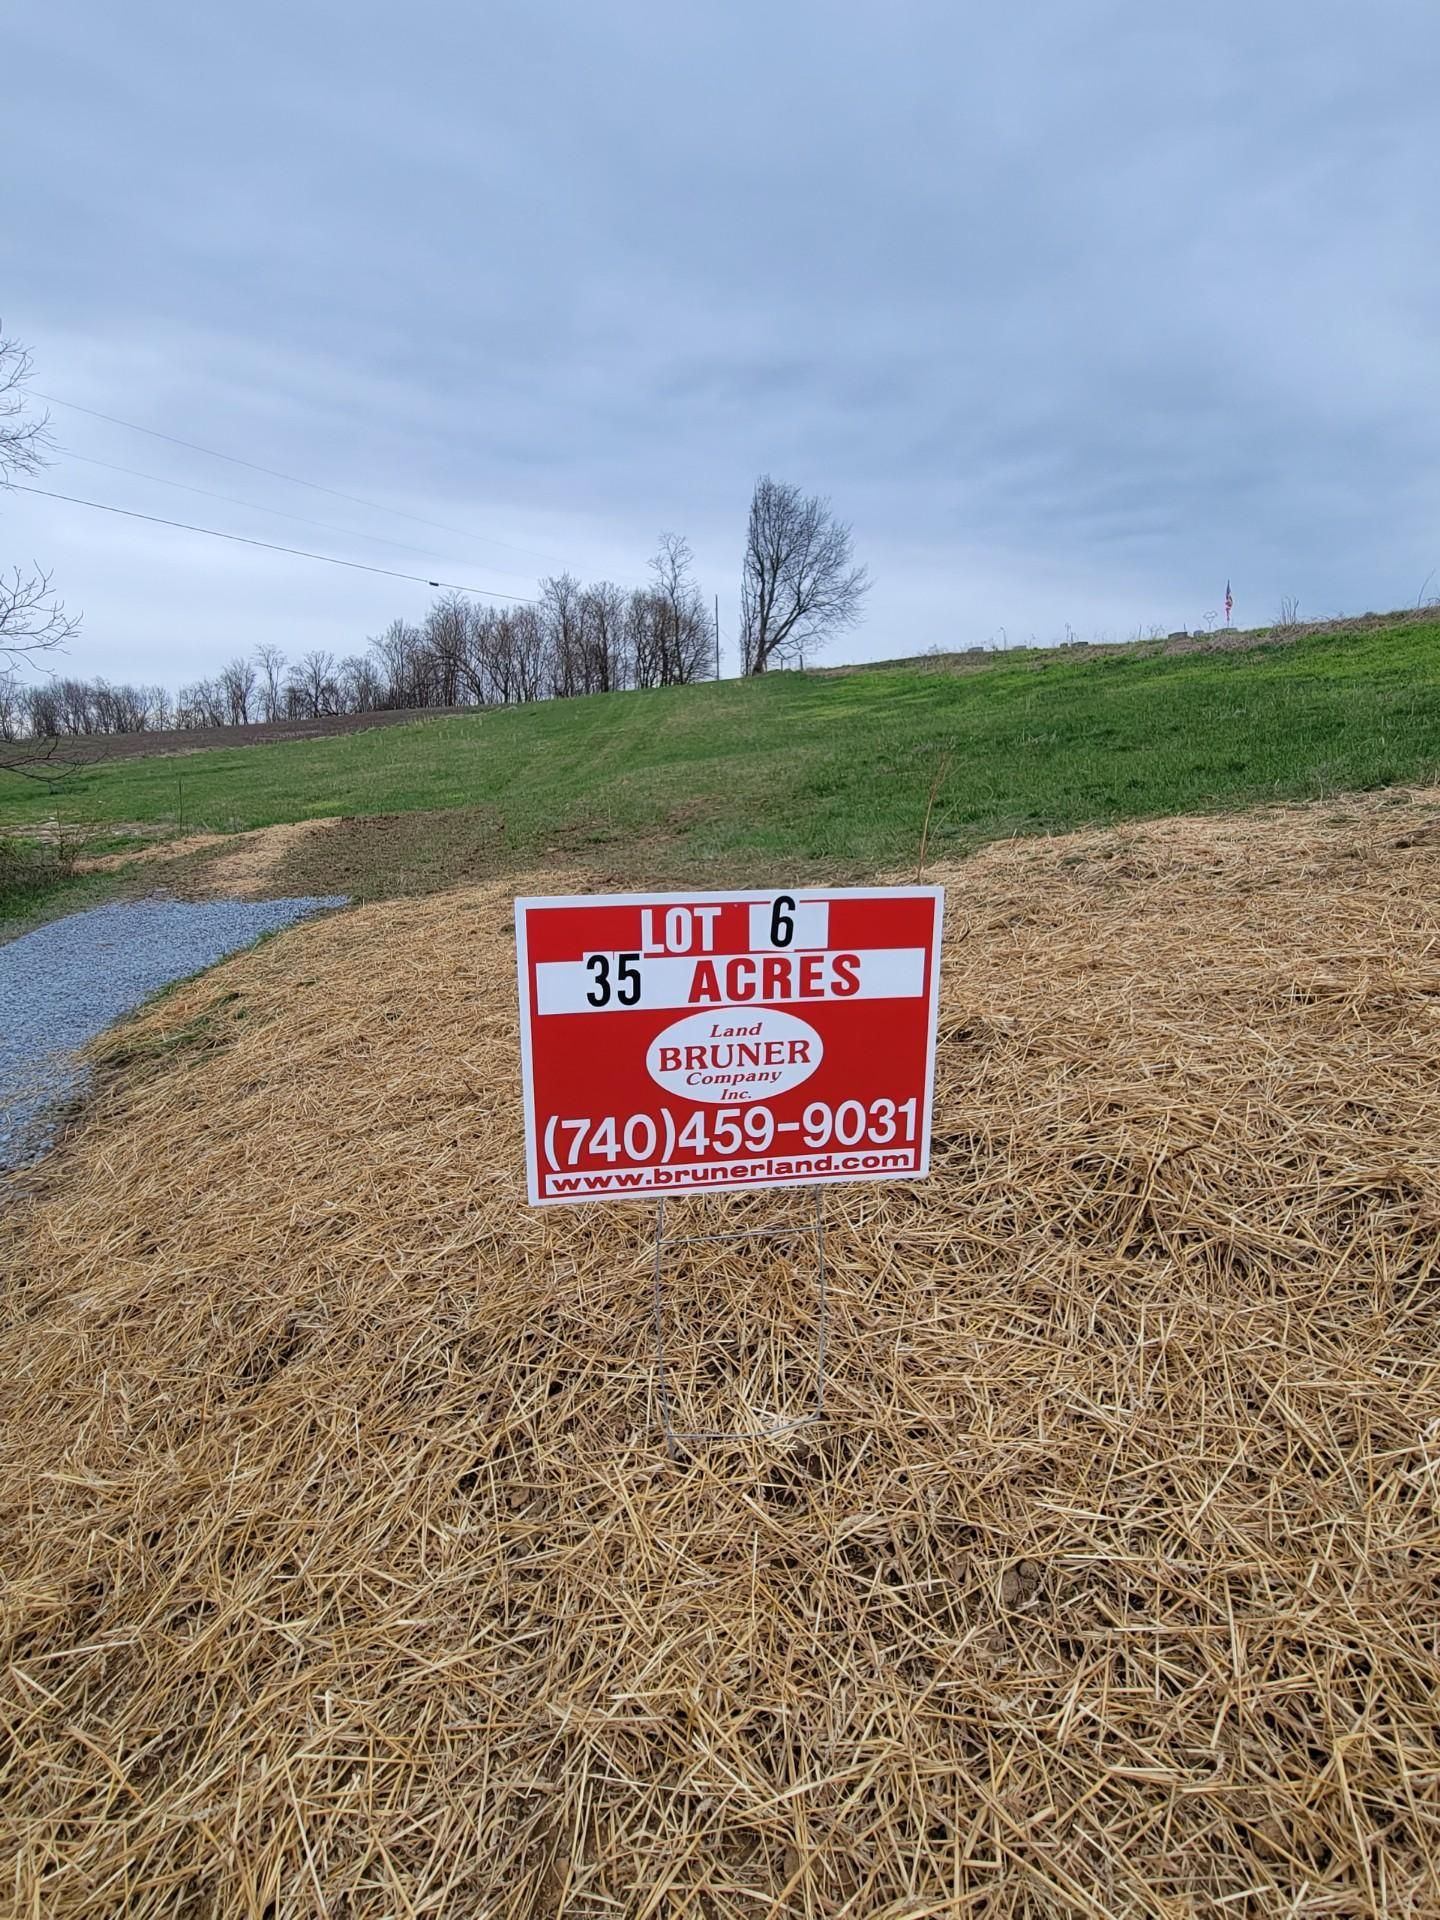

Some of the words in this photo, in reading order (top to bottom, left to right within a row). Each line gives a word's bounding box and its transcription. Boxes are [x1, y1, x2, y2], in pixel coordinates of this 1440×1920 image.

[641, 907, 722, 954] LOT
[770, 895, 796, 948] 6
[586, 953, 641, 1007] 35
[688, 954, 861, 1003] ACRES
[710, 1022, 763, 1038] Land
[658, 1039, 811, 1072] BRUNER
[686, 1069, 782, 1086] Company
[720, 1088, 752, 1101] Inc.
[544, 1097, 917, 1171] (740)459-9031
[552, 1152, 910, 1192] www.brunerland.com
